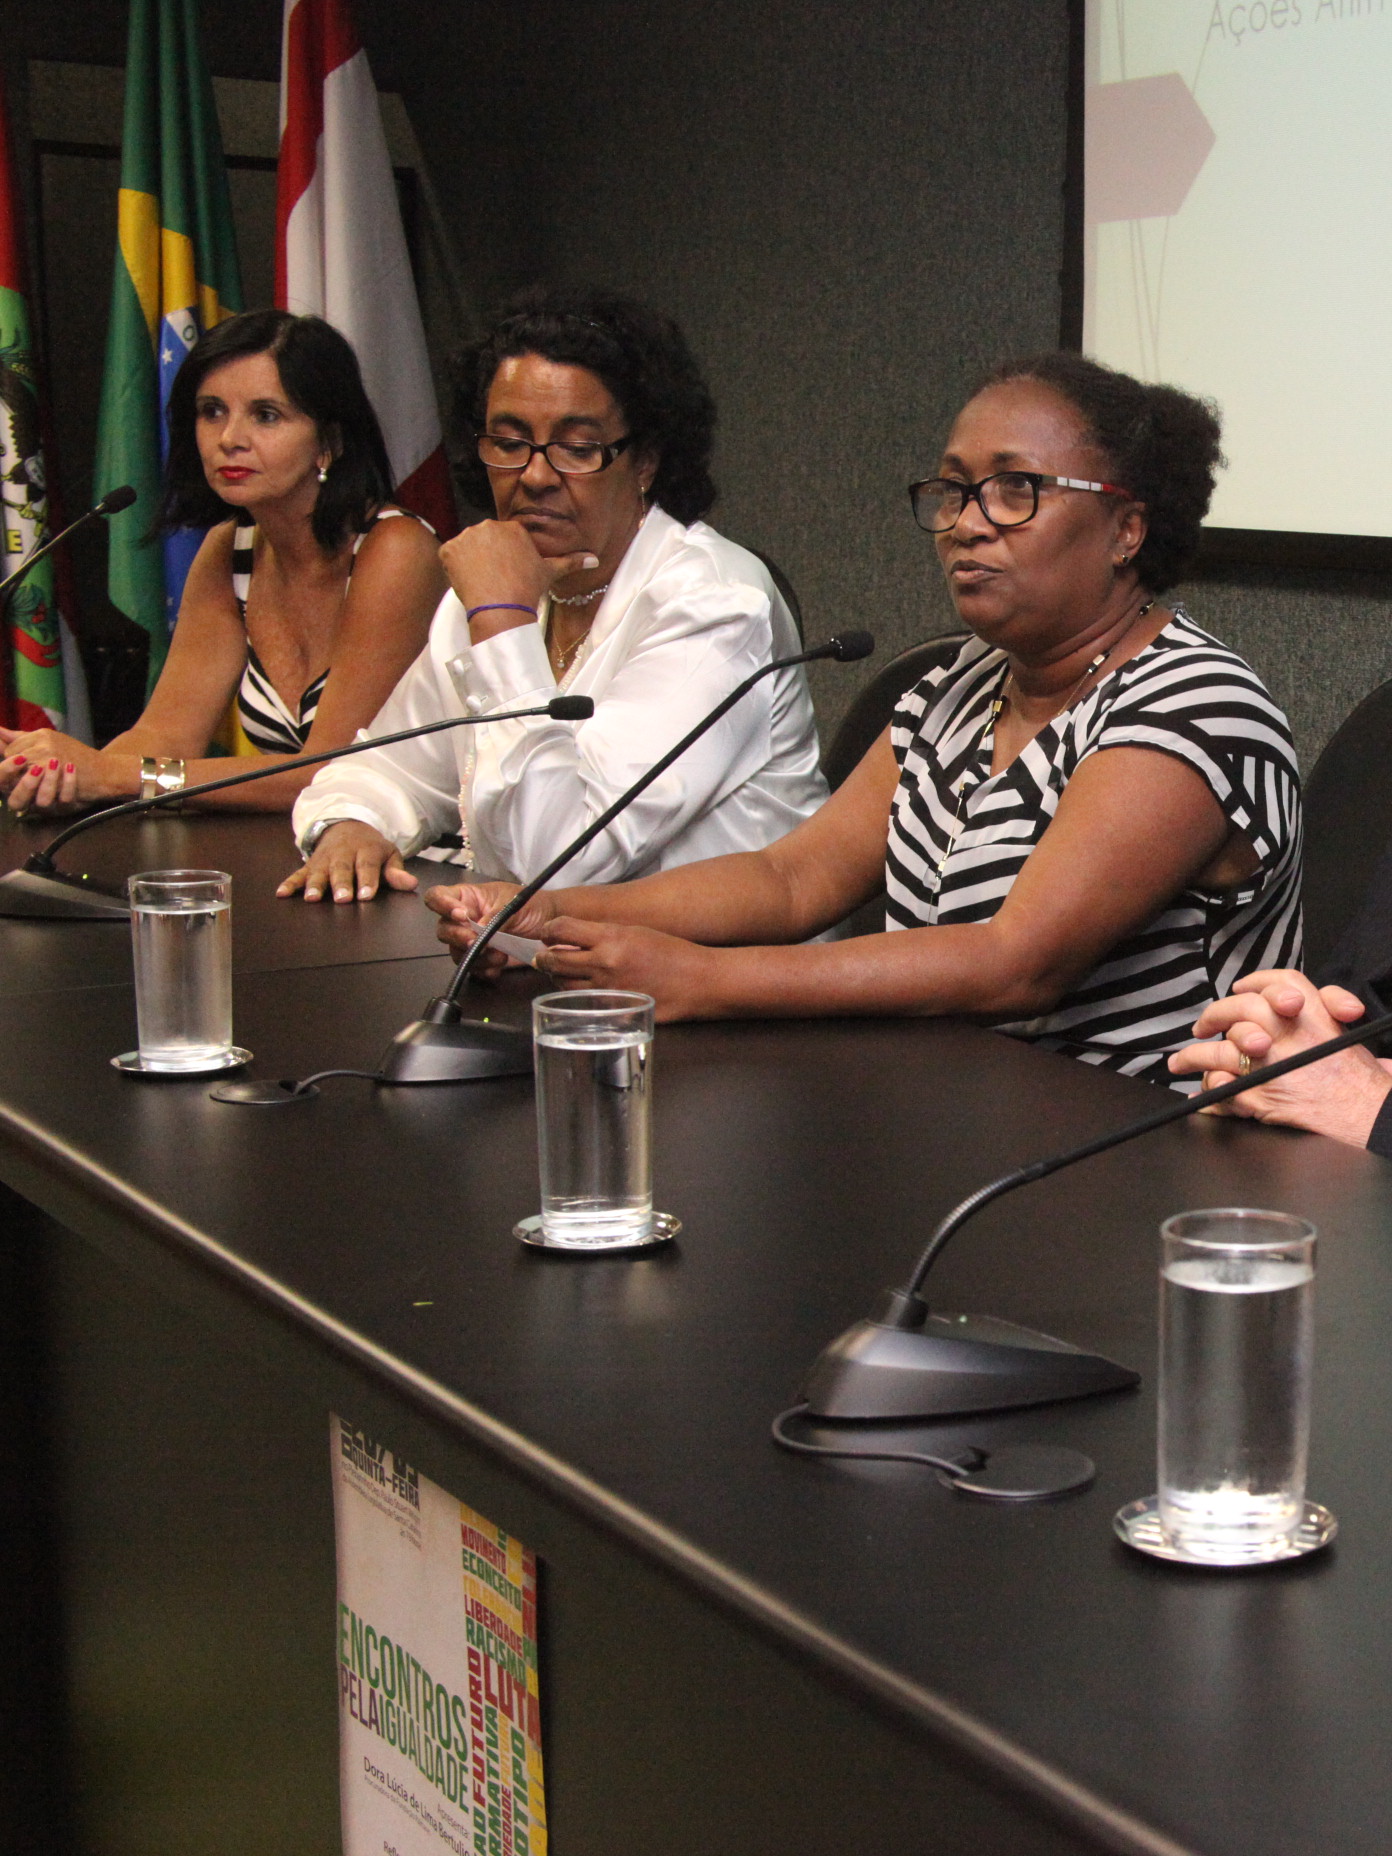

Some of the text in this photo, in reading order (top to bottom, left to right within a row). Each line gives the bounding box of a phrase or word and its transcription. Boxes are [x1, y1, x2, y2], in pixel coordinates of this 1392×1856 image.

[464, 1593, 524, 1659] LIBERDADE
[465, 1615, 527, 1689] RACISMO
[338, 1600, 468, 1763] ENCONTROS
[467, 1645, 486, 1809] FUTURO
[363, 1756, 385, 1784] Dora
[386, 1772, 408, 1802] Lúcia
[409, 1793, 420, 1813] de
[420, 1801, 438, 1832] Lima
